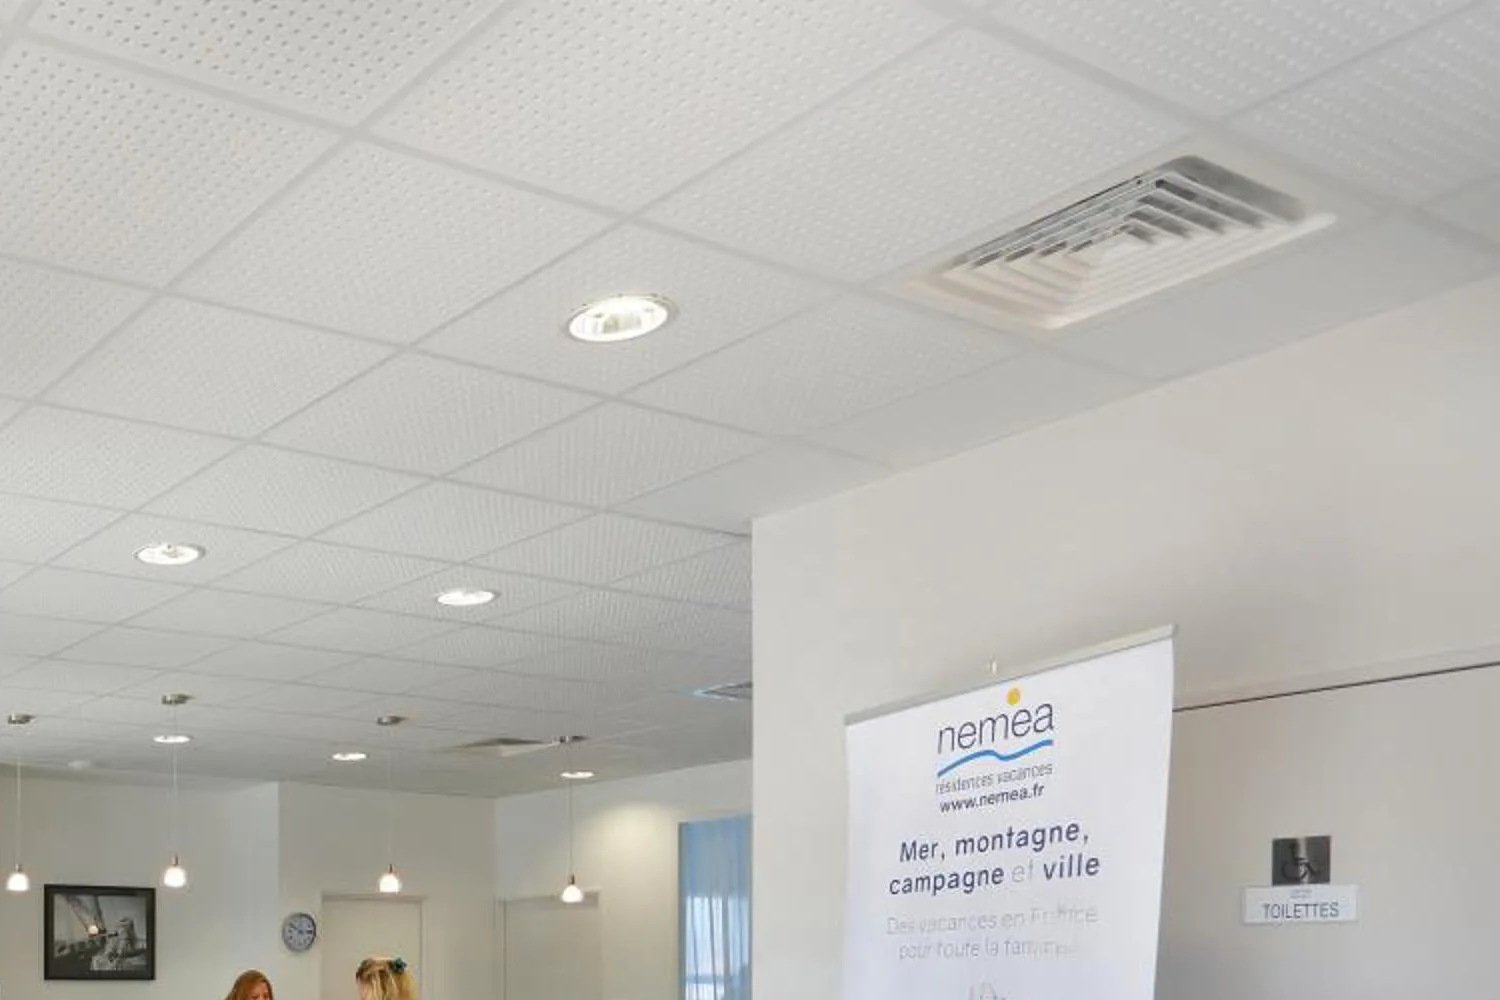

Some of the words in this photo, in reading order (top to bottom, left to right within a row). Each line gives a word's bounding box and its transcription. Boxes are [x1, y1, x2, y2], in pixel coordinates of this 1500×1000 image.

[937, 702, 1055, 754] nemea
[939, 783, 1045, 813] www.nemea.fr
[899, 839, 946, 863] Mer,
[955, 821, 1089, 857] montagne,
[888, 867, 1005, 896] campagne
[1043, 852, 1101, 881] ville
[1262, 901, 1340, 920] TOILETTES
